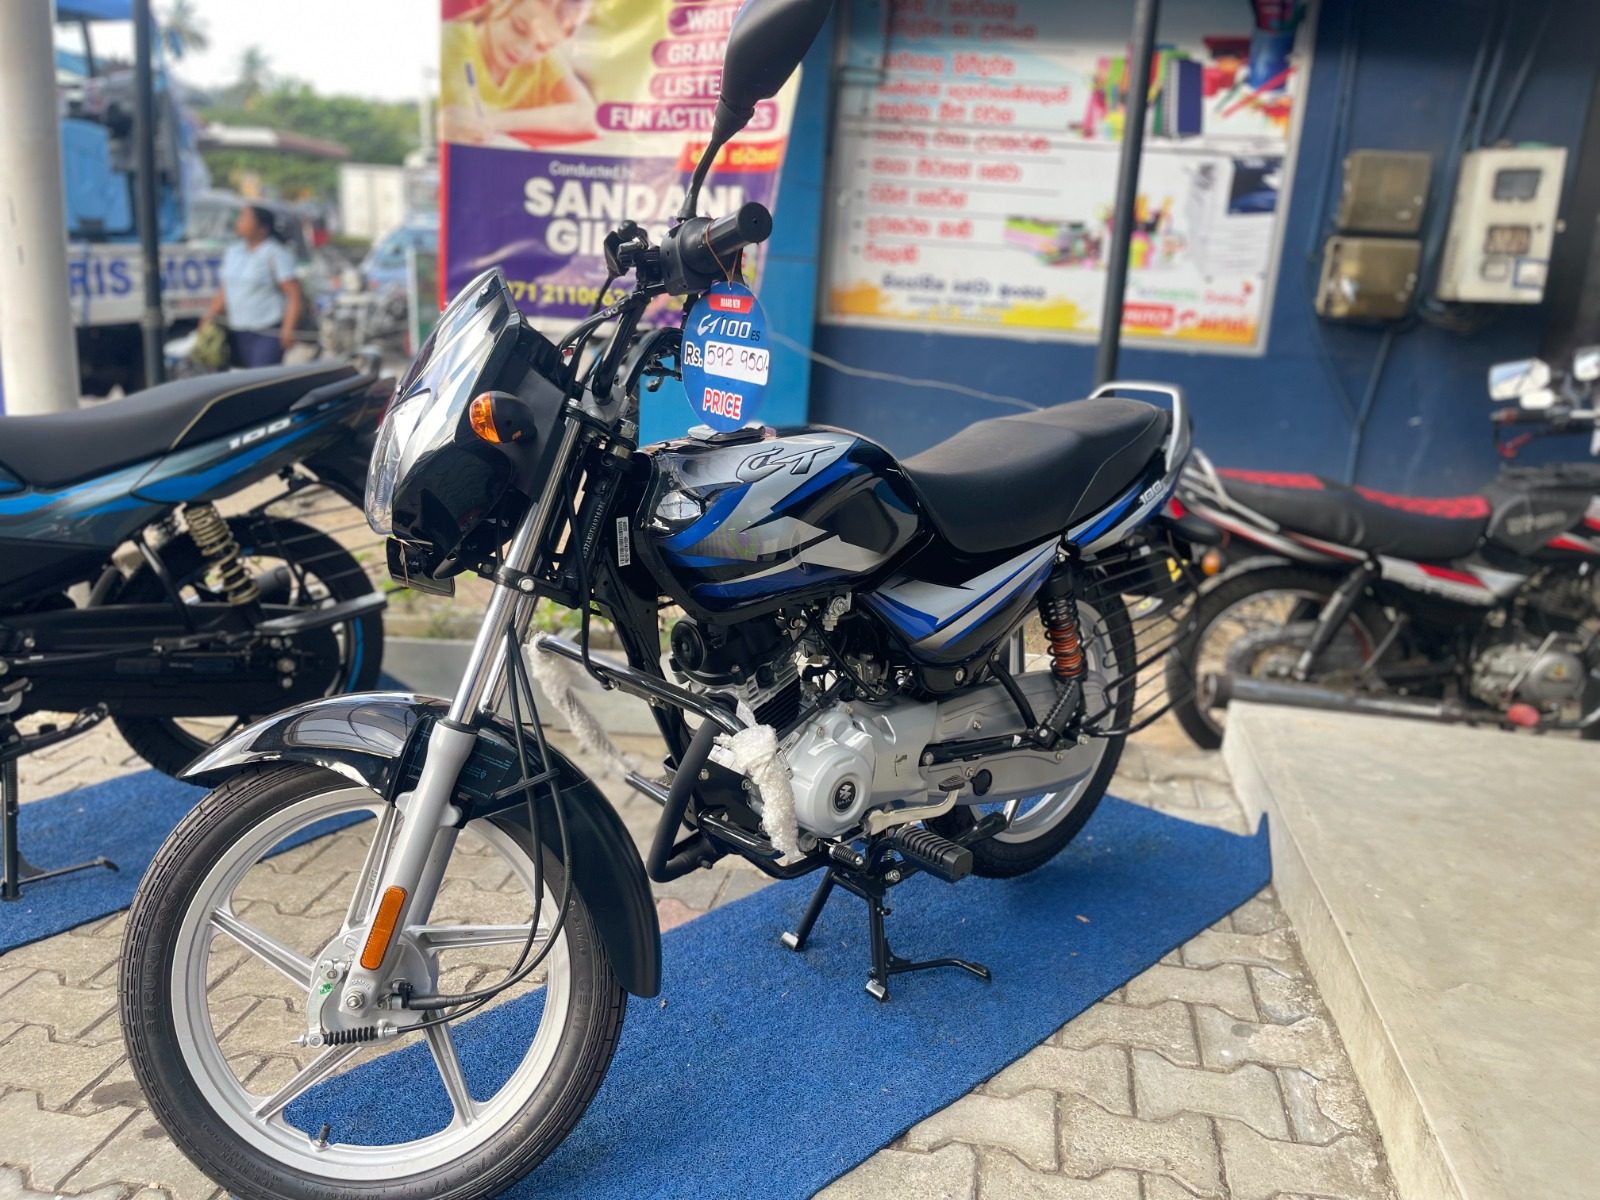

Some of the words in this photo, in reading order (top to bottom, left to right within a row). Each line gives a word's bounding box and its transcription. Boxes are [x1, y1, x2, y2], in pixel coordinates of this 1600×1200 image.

[609, 106, 654, 129] FUN
[549, 160, 619, 179] Conducted
[523, 176, 744, 219] SANDANI
[751, 330, 761, 341] ES
[685, 342, 703, 367] Rs.
[707, 344, 734, 367] 592
[703, 388, 742, 420] PRICE
[228, 417, 292, 450] 100
[1138, 480, 1163, 505] 100
